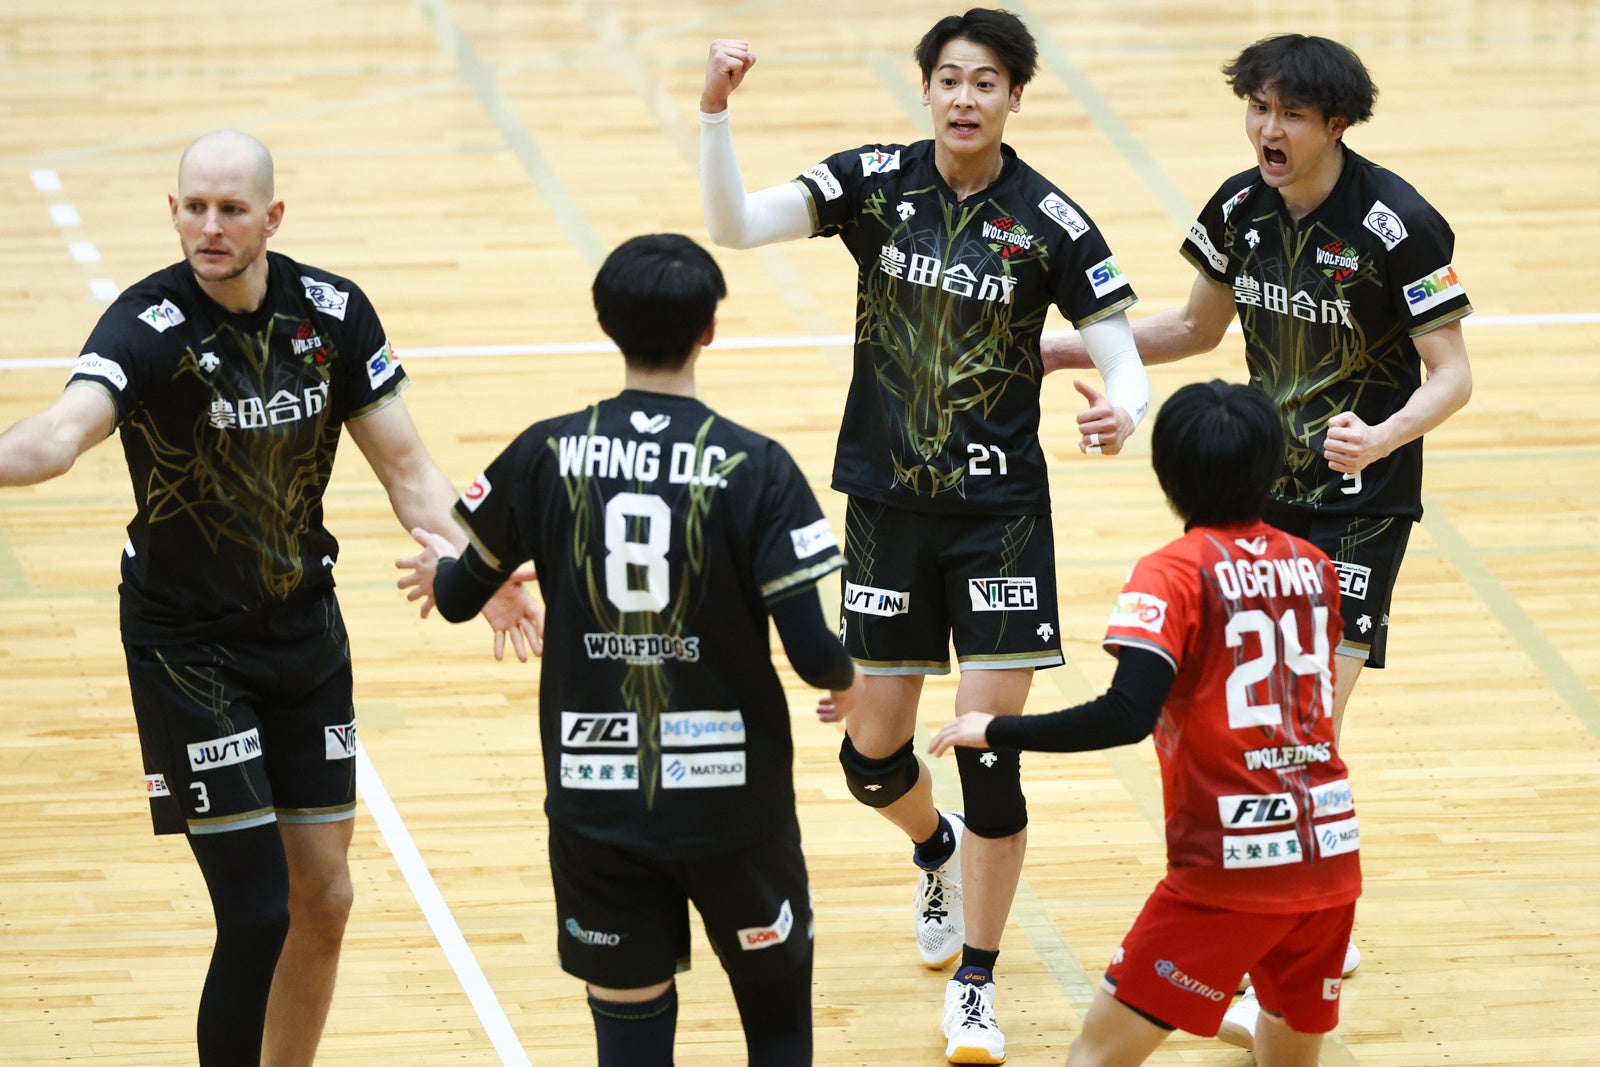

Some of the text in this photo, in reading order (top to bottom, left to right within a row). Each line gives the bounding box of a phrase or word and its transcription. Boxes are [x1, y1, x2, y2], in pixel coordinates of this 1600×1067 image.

[982, 221, 1034, 250] WOLFDOGS
[1316, 247, 1359, 271] WOLFDOGS
[879, 245, 1018, 305] 豊田合成
[1232, 274, 1353, 330] 豊田合成
[559, 435, 728, 489] WANG D.C.
[967, 443, 1008, 475] 21
[604, 492, 672, 613] 8
[1214, 557, 1325, 600] OGAWA
[1336, 567, 1366, 597] EC
[846, 587, 875, 608] UST
[584, 632, 700, 663] WOLFDOGS
[1225, 606, 1334, 729] 24
[663, 718, 745, 739] Miyaco
[194, 741, 239, 765] JUST
[1244, 741, 1332, 771] WOLFDOGS
[690, 762, 743, 776] MATSUO
[189, 781, 211, 814] 3
[1171, 969, 1226, 1001] ENTRIO
